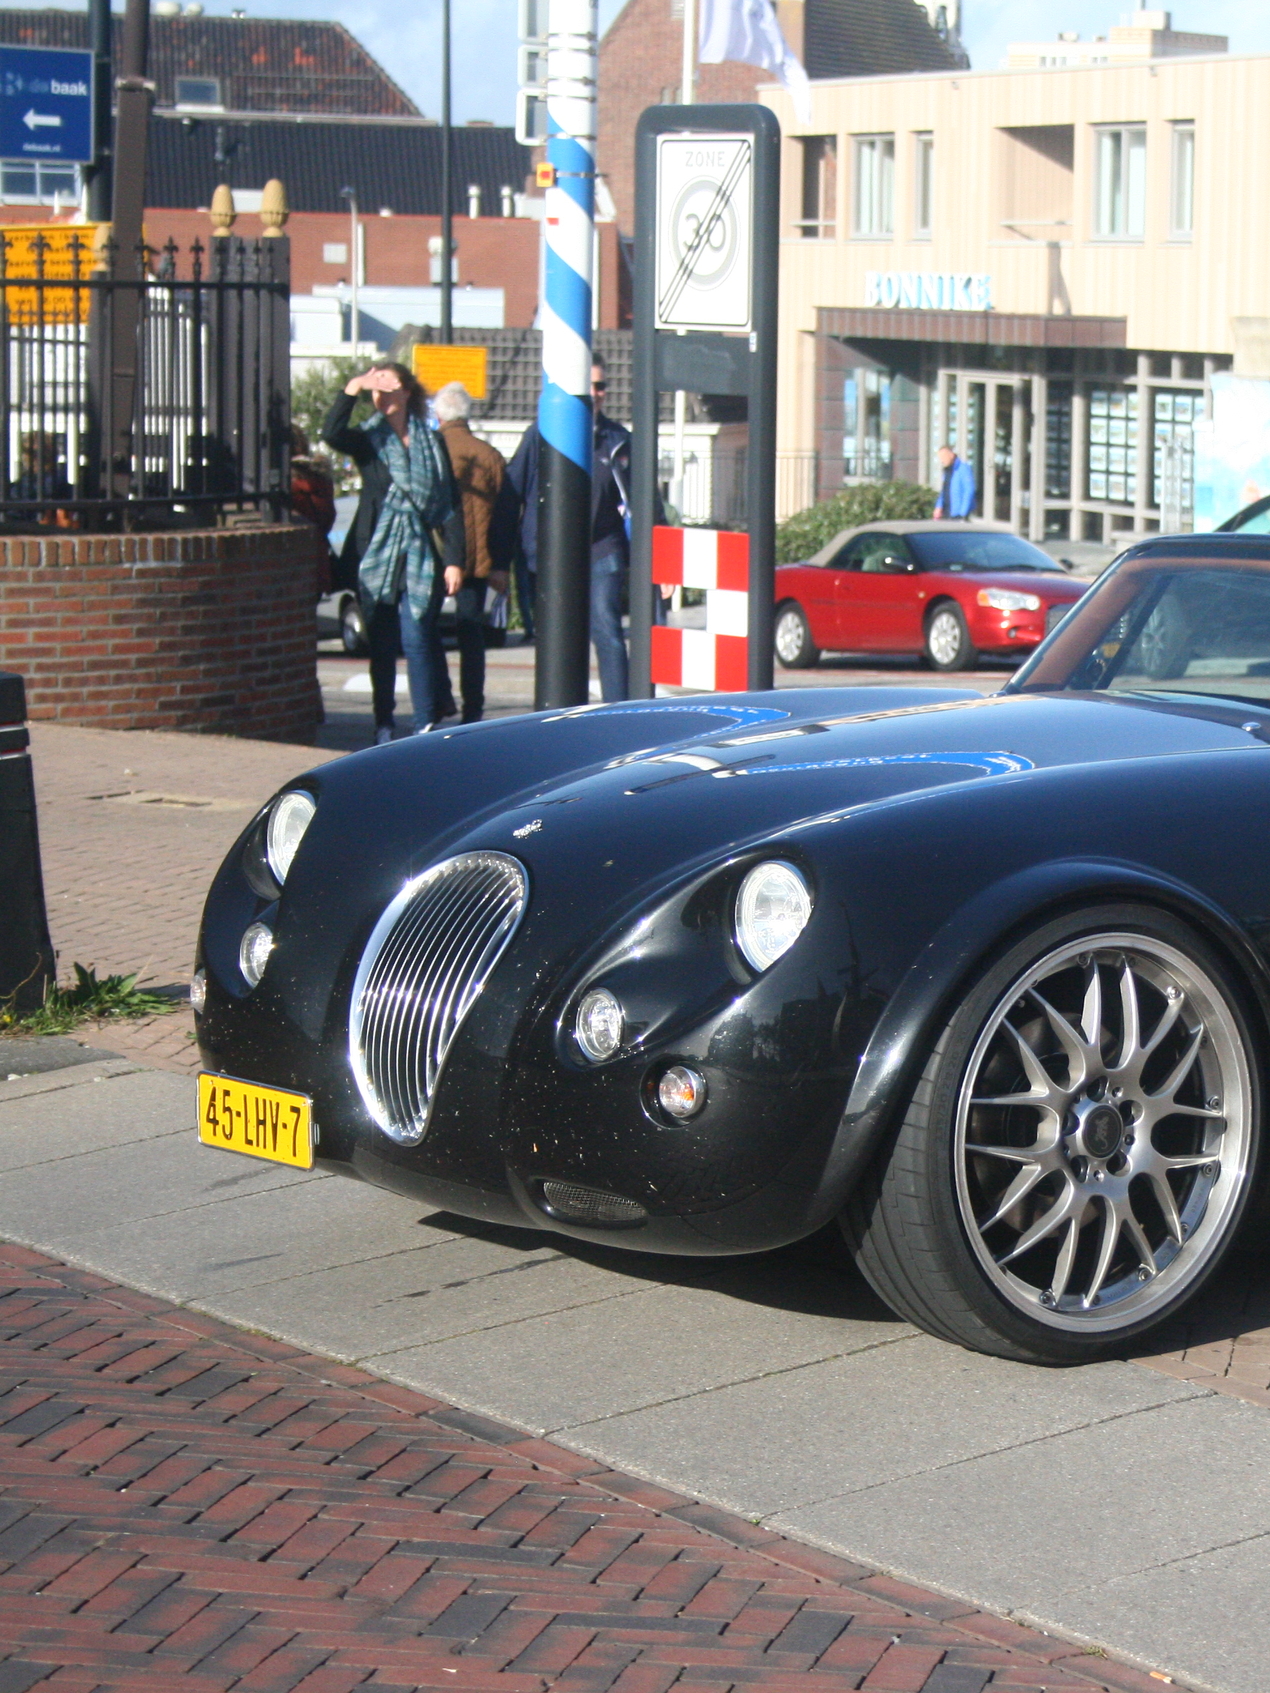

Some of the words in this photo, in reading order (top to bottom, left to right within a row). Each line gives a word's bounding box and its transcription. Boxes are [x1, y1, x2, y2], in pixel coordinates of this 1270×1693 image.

[685, 151, 726, 168] ZONE
[682, 212, 727, 253] 30
[864, 271, 992, 311] BONNIKE
[206, 1086, 301, 1158] 45-LHV-7
